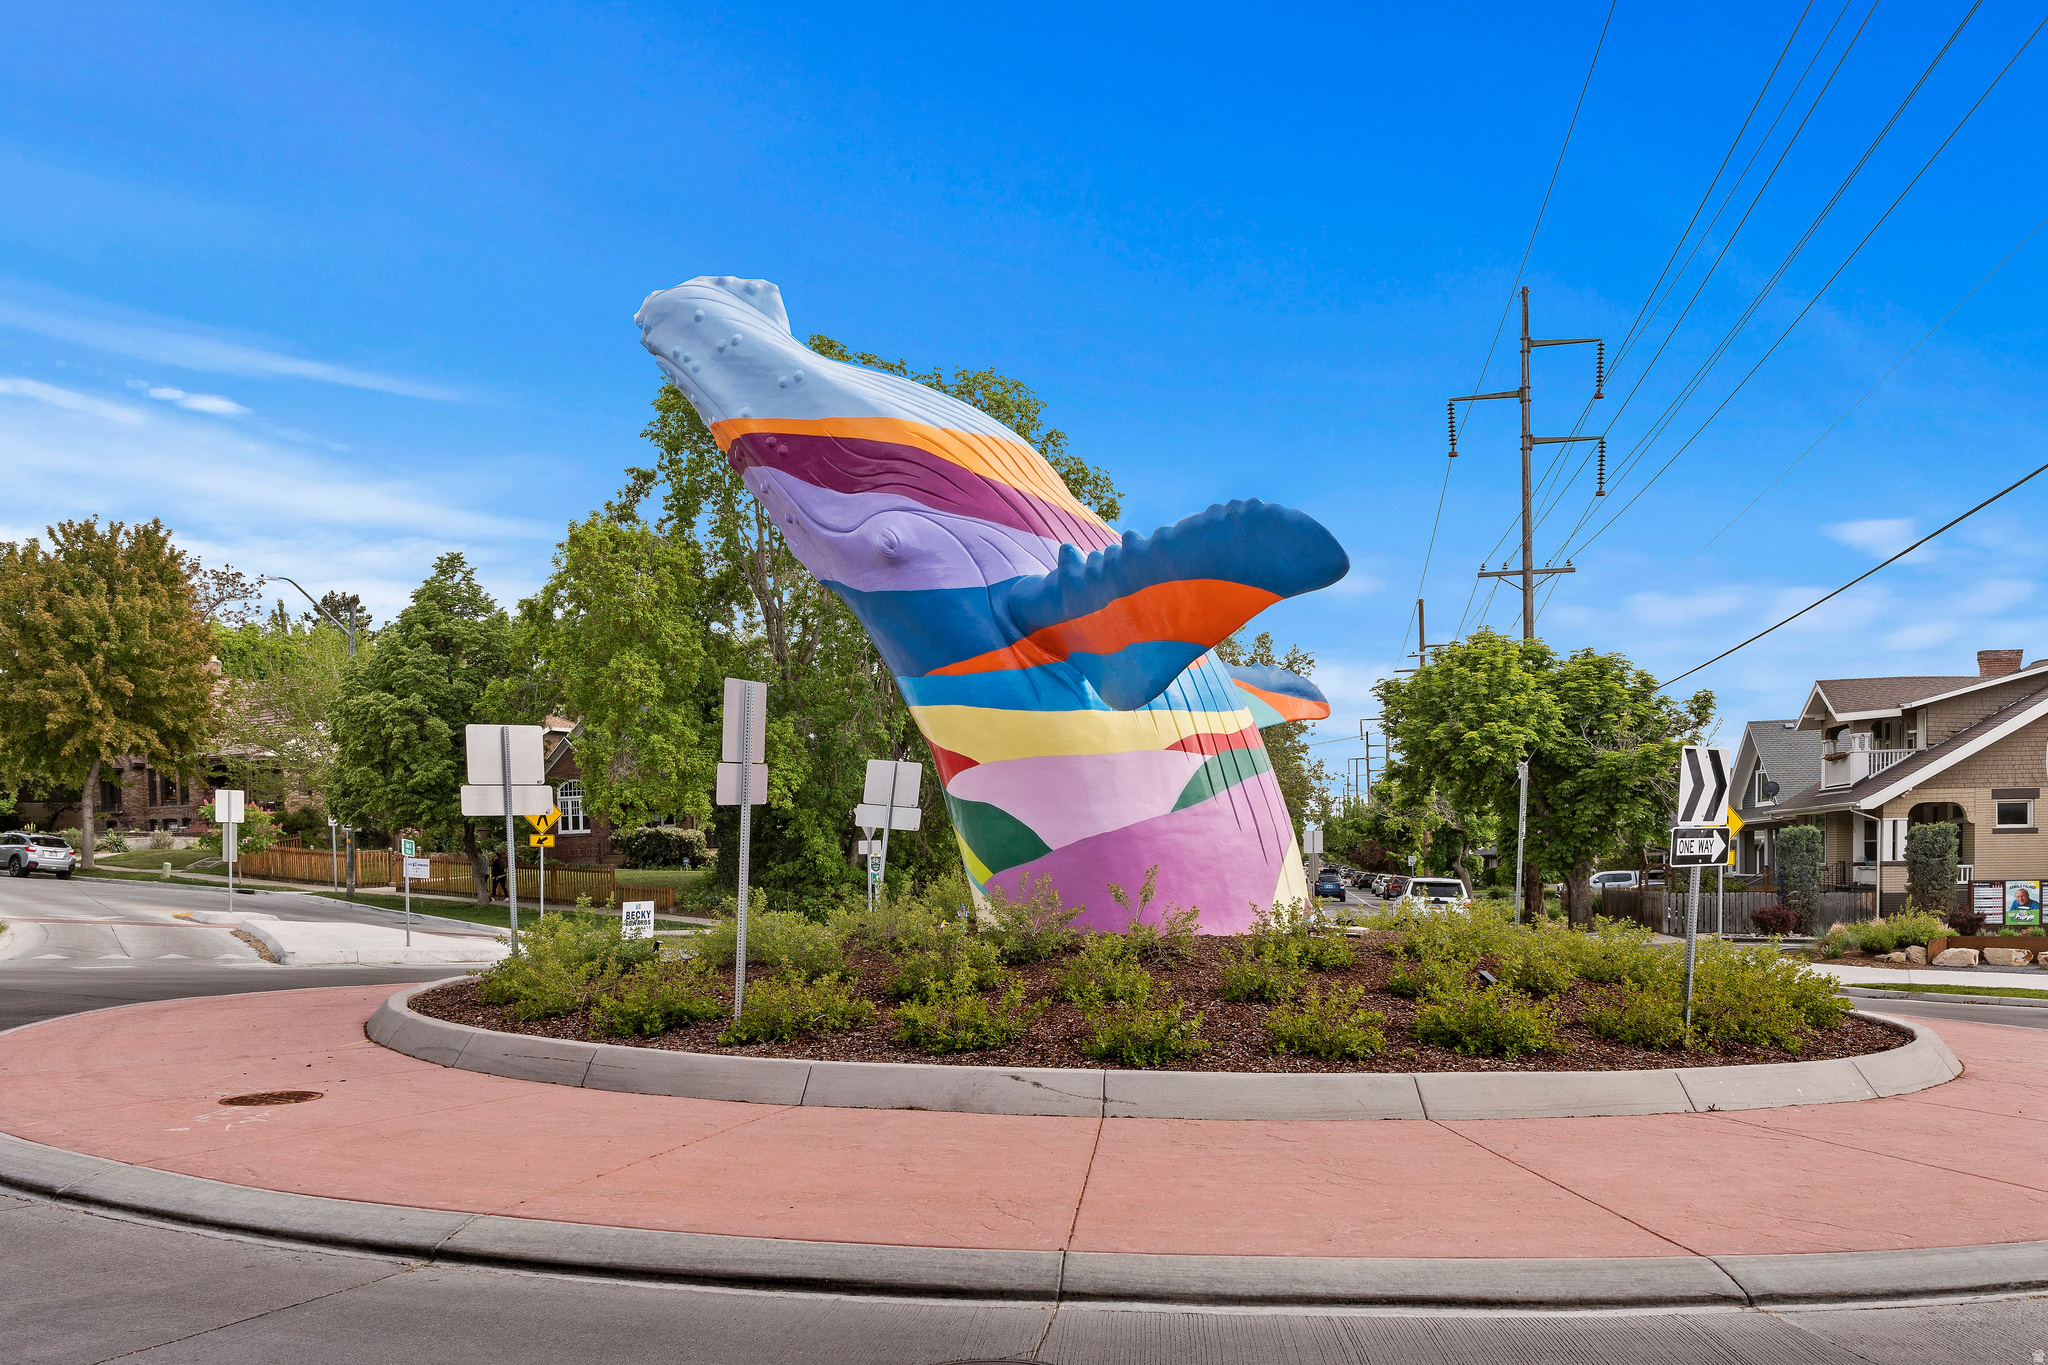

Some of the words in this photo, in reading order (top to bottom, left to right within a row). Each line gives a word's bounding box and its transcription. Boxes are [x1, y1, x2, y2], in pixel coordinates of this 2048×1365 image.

[1679, 840, 1694, 854] ONE
[1698, 840, 1714, 853] WAY
[626, 910, 651, 920] BECKY
